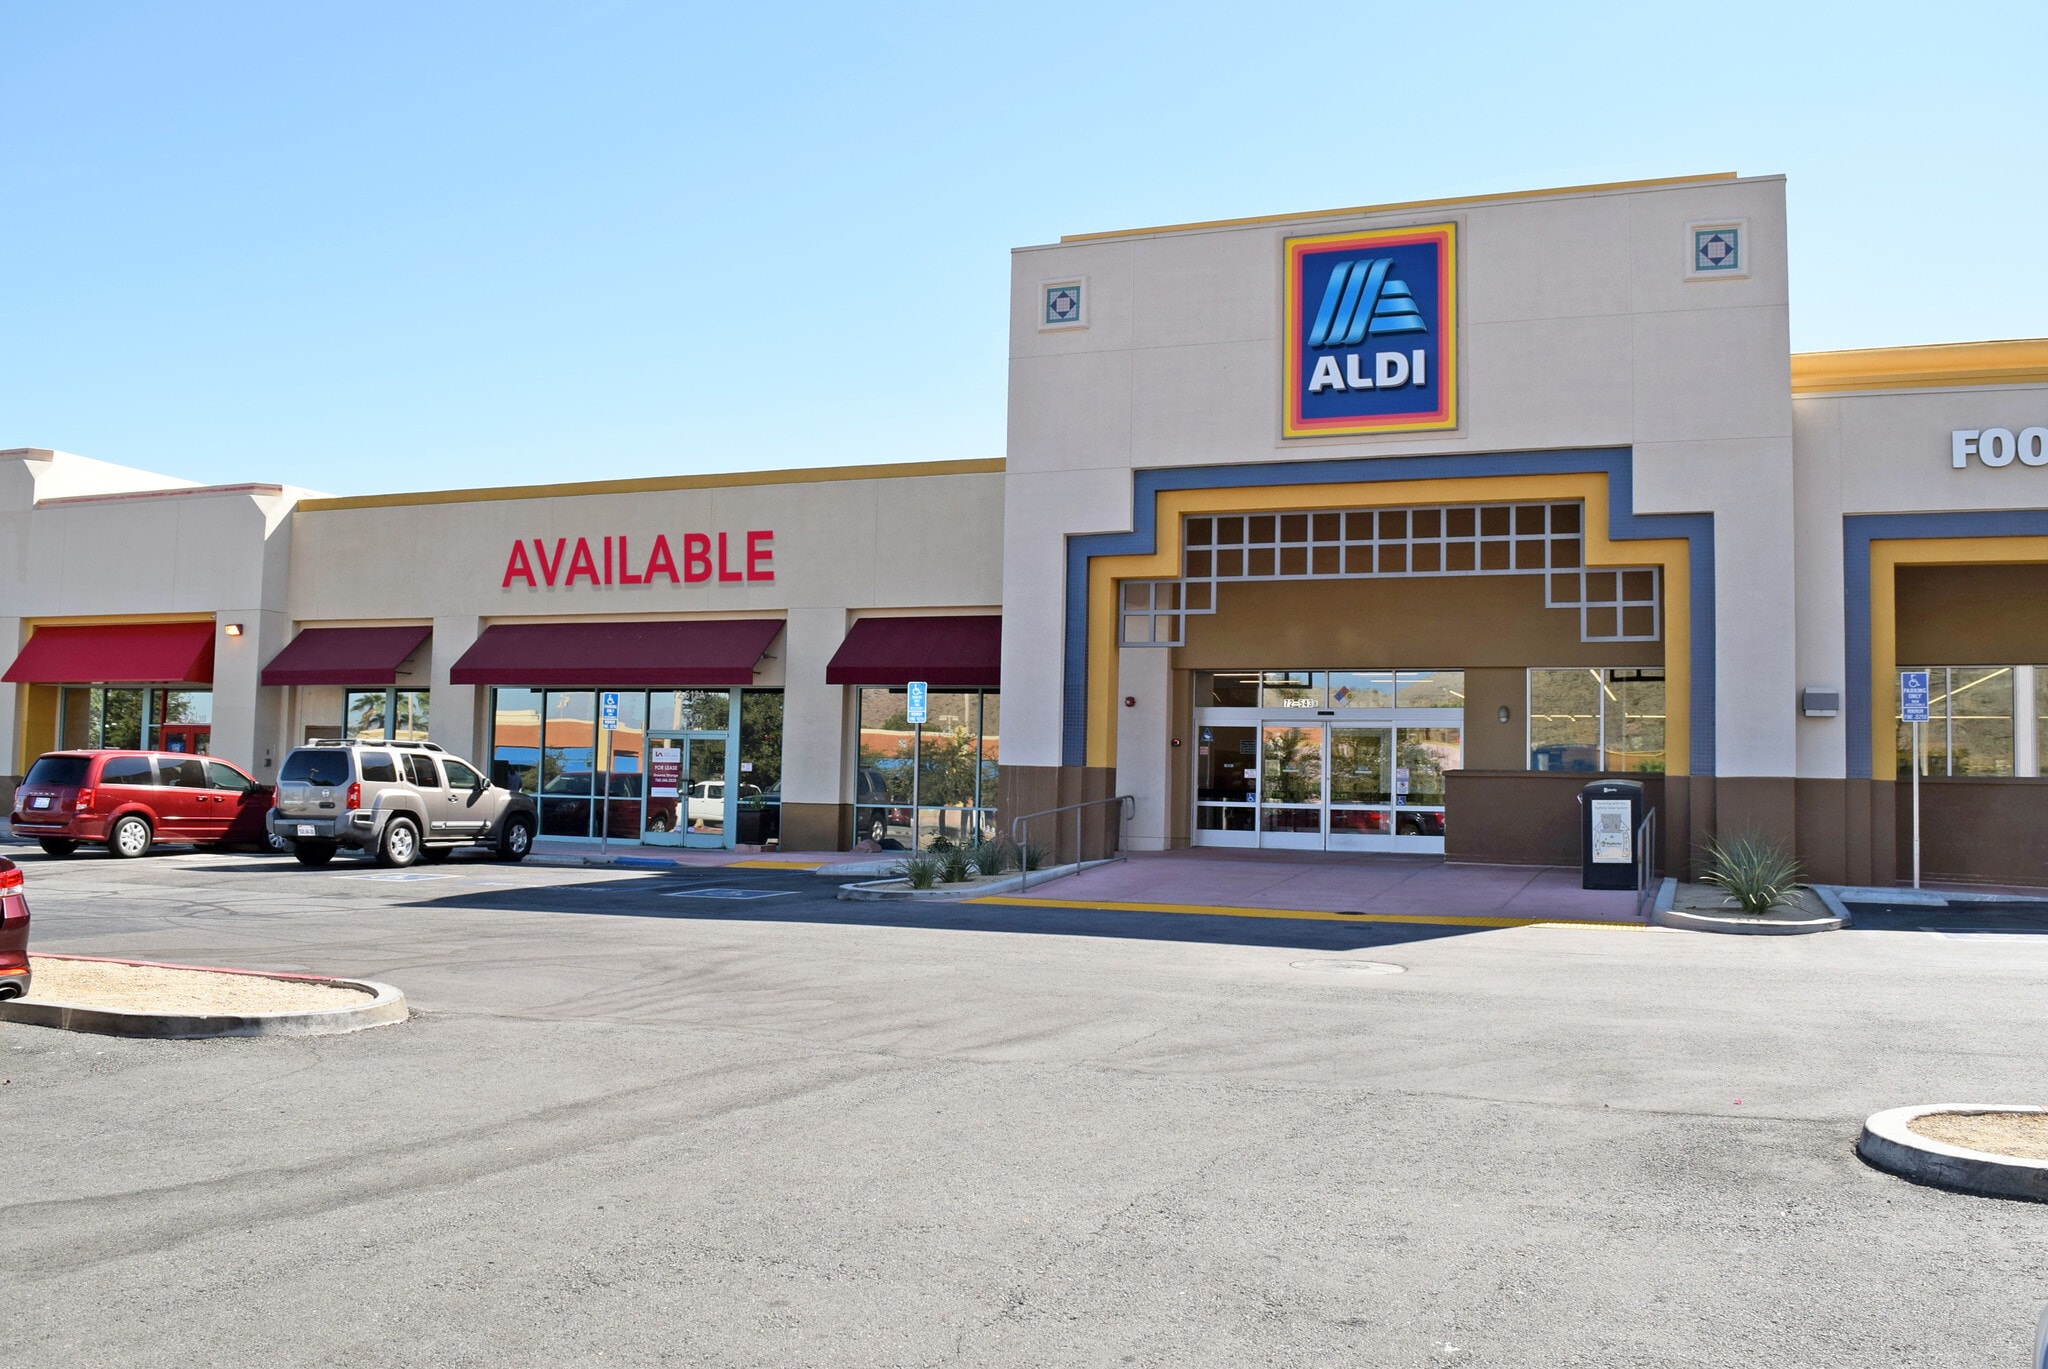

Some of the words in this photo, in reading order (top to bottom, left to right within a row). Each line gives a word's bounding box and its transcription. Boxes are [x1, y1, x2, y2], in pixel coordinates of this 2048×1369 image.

[1308, 349, 1425, 393] ALDI
[1952, 426, 2048, 469] FOO
[501, 530, 775, 588] AVAILABLE
